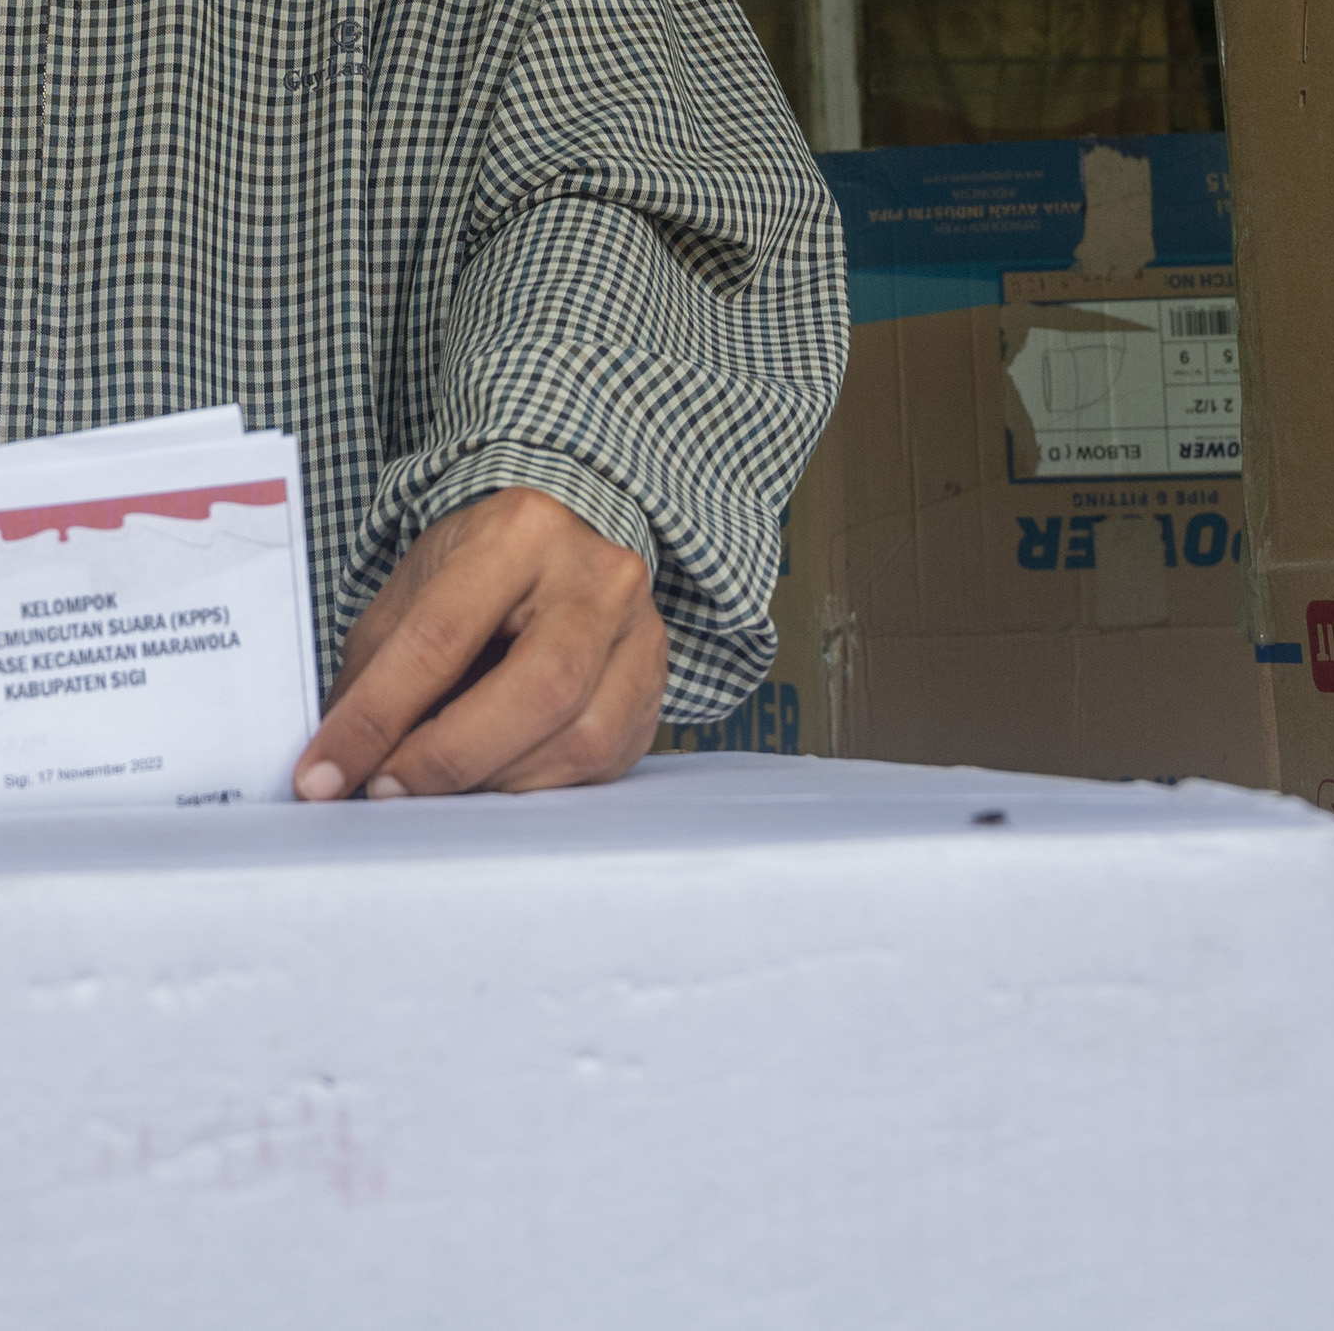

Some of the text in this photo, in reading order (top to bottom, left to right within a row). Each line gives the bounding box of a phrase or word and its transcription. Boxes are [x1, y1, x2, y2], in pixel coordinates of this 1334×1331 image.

[1075, 444, 1141, 461] ELBOW
[1072, 491, 1148, 507] FITTING
[1175, 490, 1219, 506] PIPE
[20, 592, 118, 619] KELOMPOK
[107, 613, 167, 636] SUARA
[170, 605, 231, 632] (KPPS)
[31, 642, 137, 671] KECAMATAN
[140, 630, 242, 659] MARAWOLA
[4, 667, 147, 701] KABUPATEN SIGI
[57, 762, 127, 782] November
